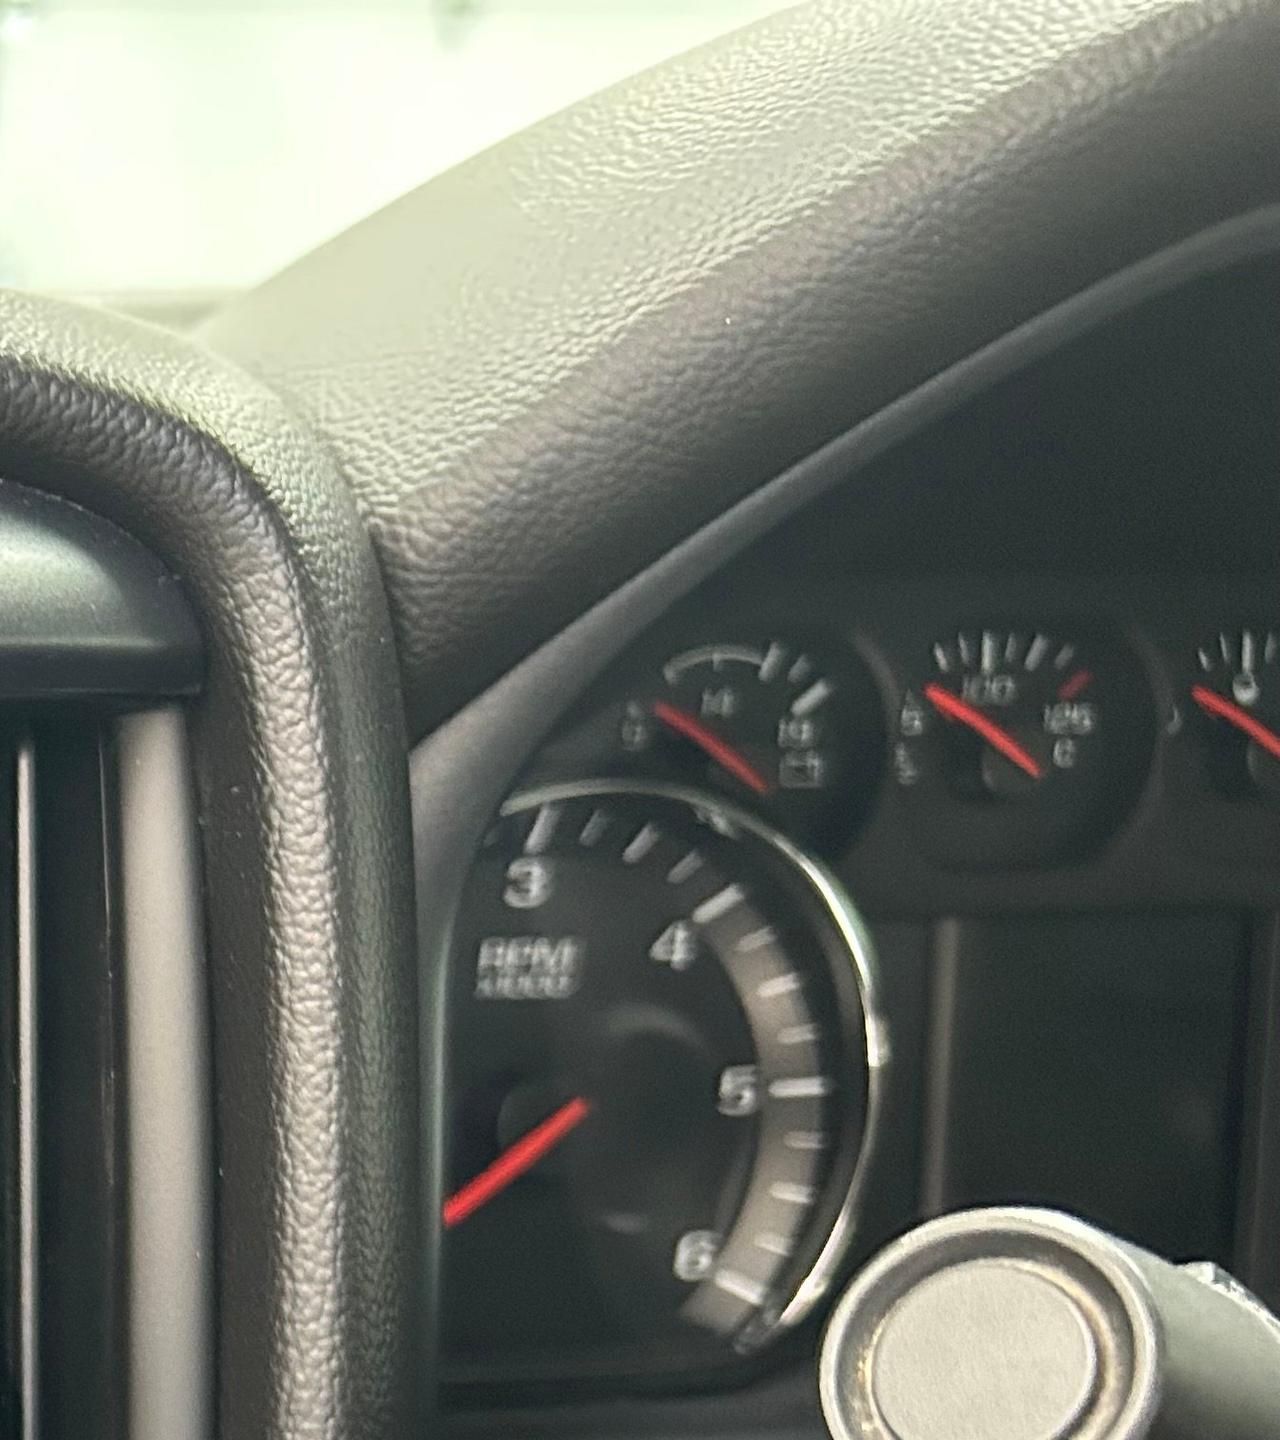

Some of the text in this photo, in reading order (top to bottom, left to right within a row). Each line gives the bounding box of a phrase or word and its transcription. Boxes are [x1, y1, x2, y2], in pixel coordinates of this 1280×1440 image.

[503, 857, 552, 909] 3
[648, 920, 694, 971] 4
[718, 1064, 756, 1117] 5
[673, 1229, 719, 1282] 6
